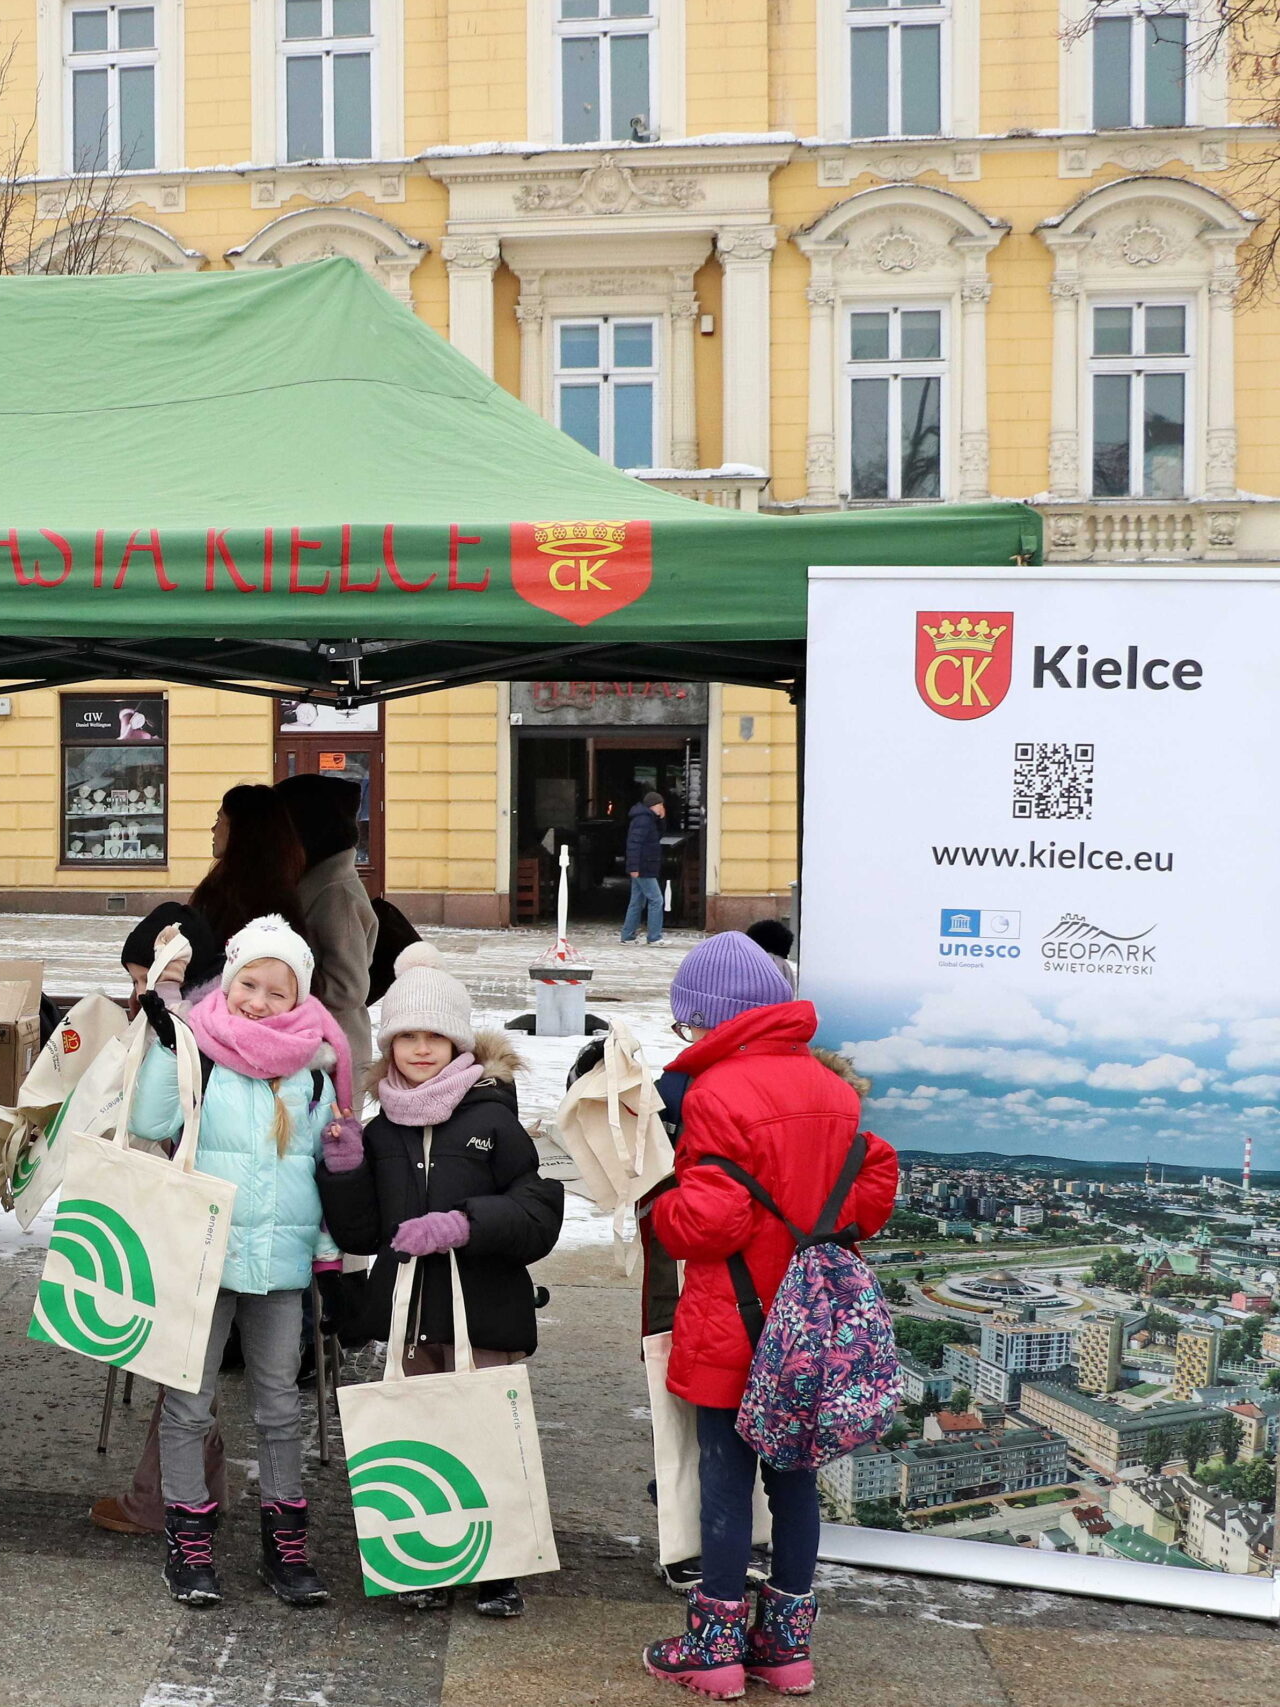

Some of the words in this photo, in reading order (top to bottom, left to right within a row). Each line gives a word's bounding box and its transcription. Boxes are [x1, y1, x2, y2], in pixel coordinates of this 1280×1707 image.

[548, 559, 612, 591] CK
[924, 654, 993, 707] CK
[1032, 644, 1203, 690] Kielce
[931, 840, 1173, 872] www.kielce.eu
[939, 943, 1021, 959] unesco
[959, 961, 984, 969] Geopark
[1041, 941, 1157, 963] GEOPARK
[1043, 961, 1153, 976] ŚWIĘTOKRZYSKI
[204, 1215, 216, 1246] eneris
[510, 1400, 521, 1431] eneris
